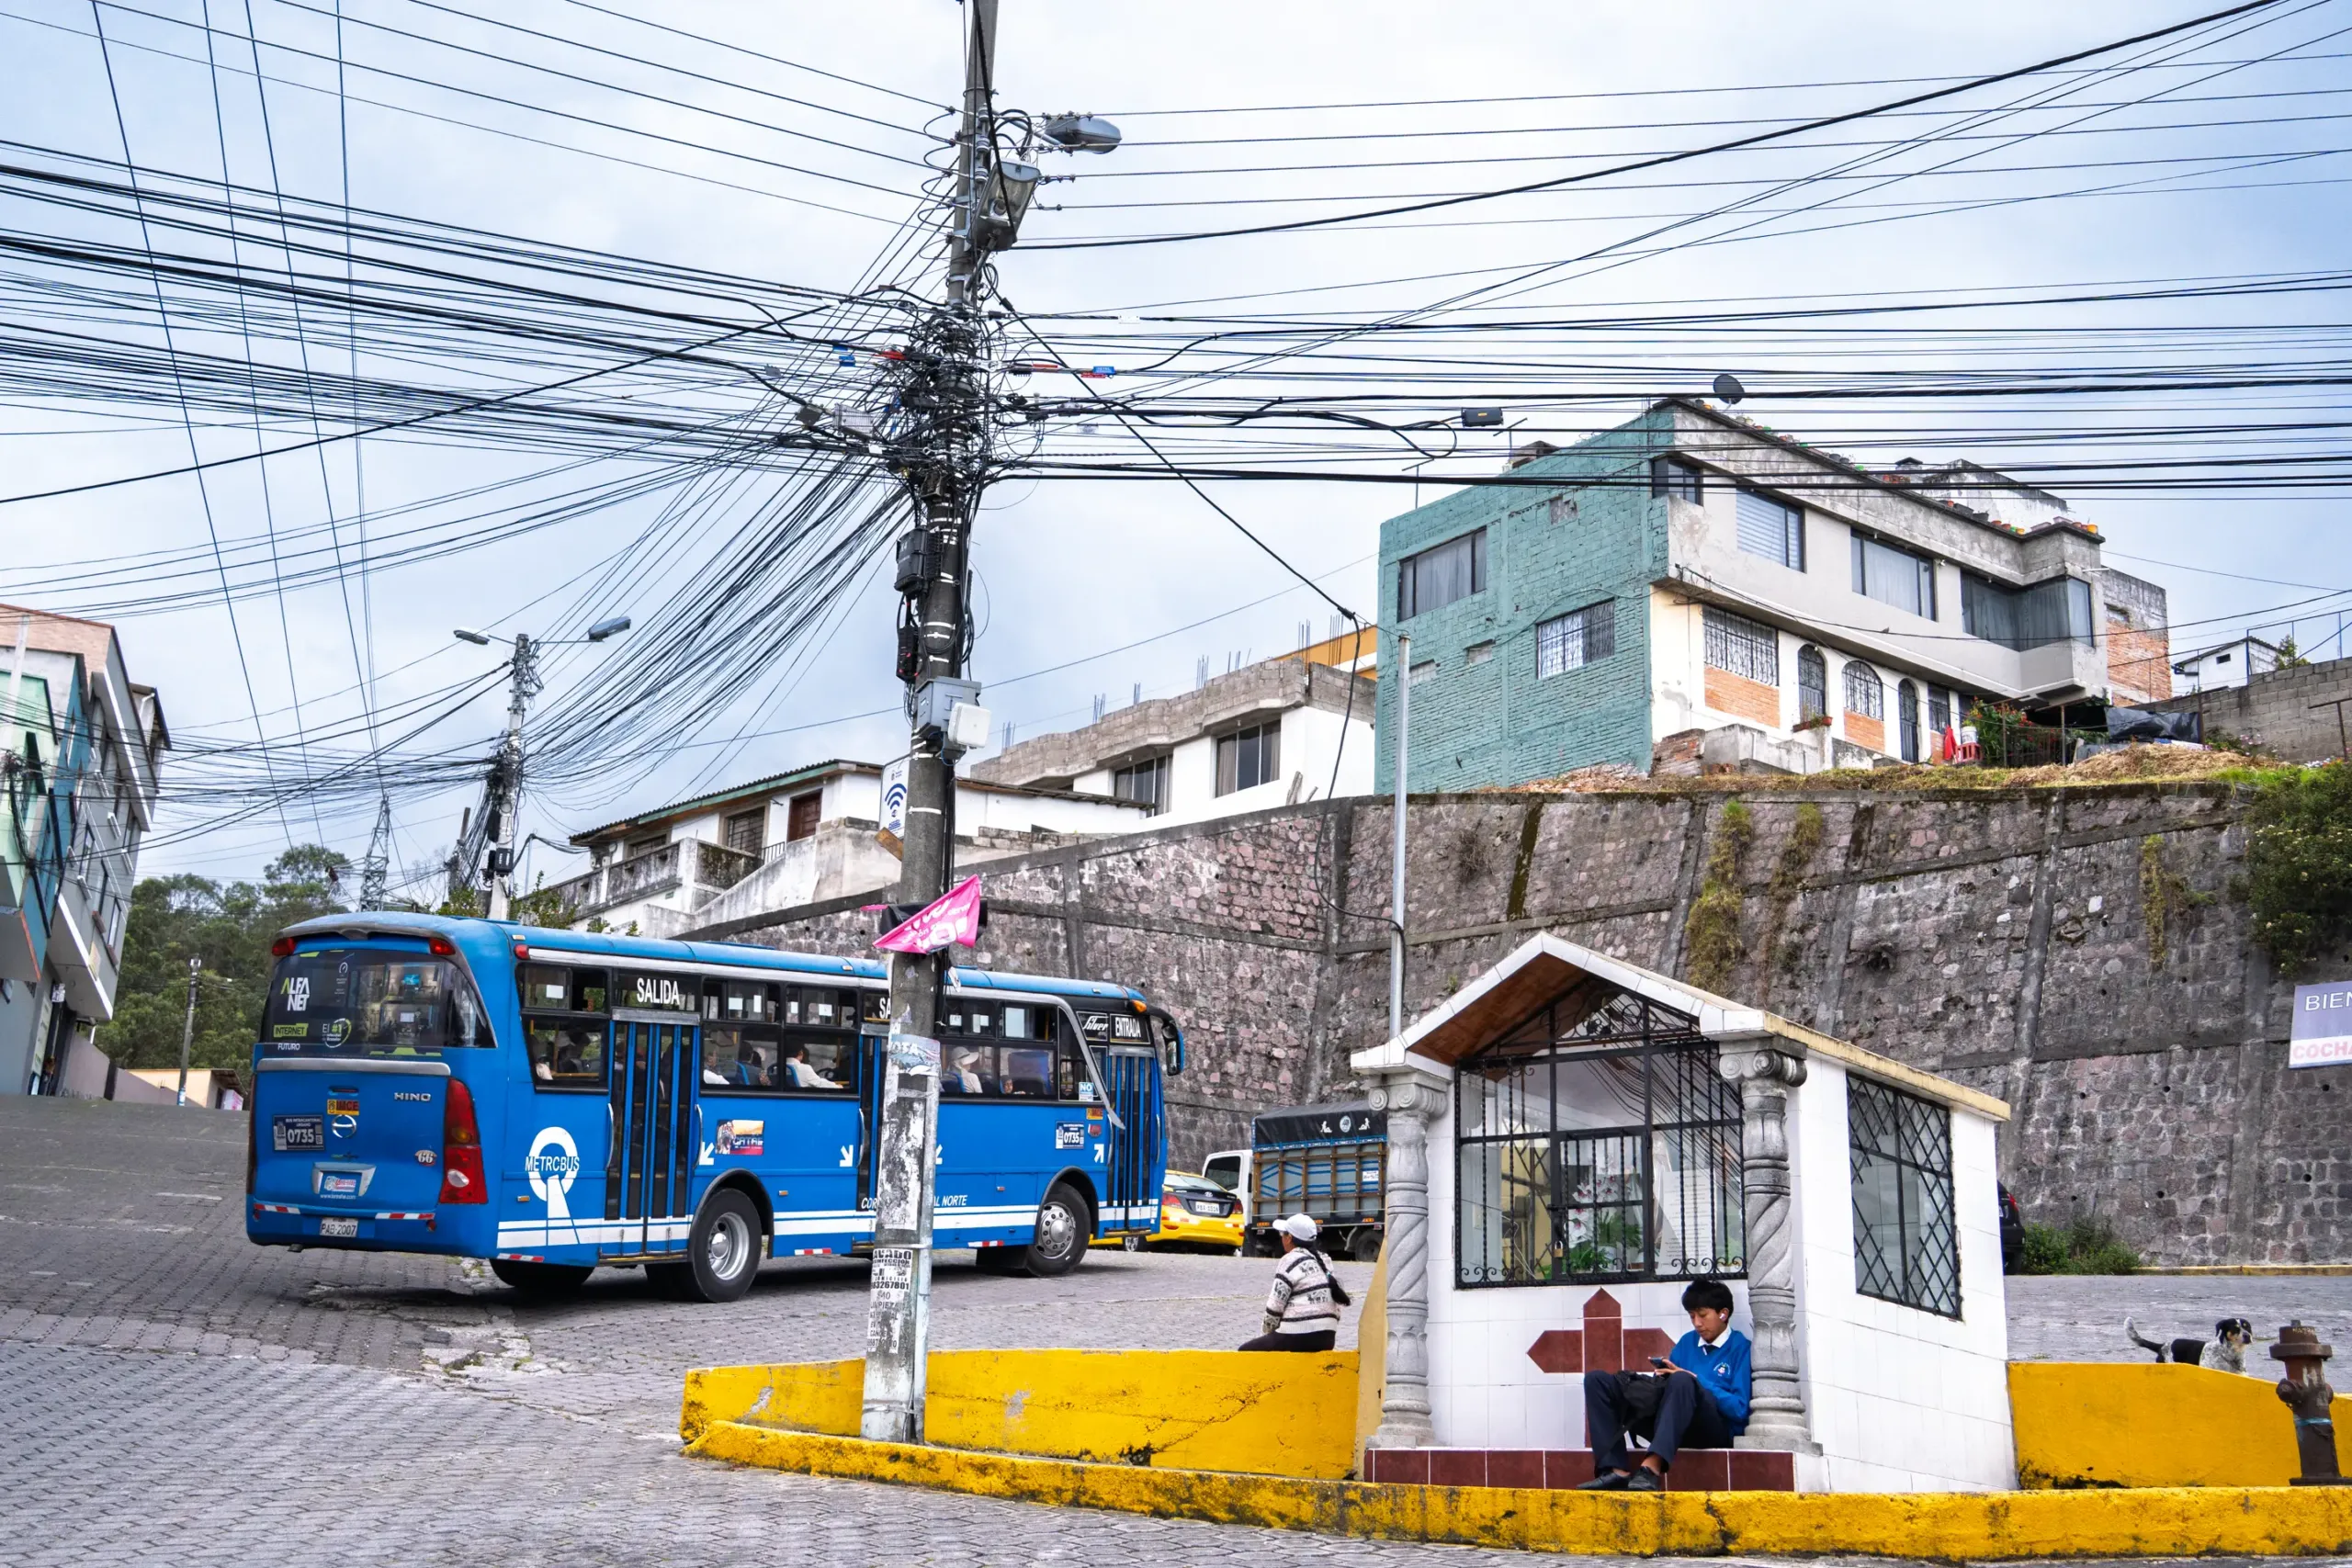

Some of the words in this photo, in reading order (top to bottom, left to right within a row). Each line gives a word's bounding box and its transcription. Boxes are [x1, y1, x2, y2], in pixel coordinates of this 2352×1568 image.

[280, 977, 310, 995] ALFA
[637, 977, 680, 1006] SALIDA
[287, 994, 310, 1011] NET
[275, 1026, 305, 1035] INTERNET
[1114, 1017, 1141, 1038] ENTRADA
[277, 1043, 300, 1051] FUTURO
[2292, 1040, 2352, 1060] COCH
[1080, 1083, 1092, 1092] NO
[394, 1092, 431, 1102] HINO
[288, 1128, 314, 1144] 0735
[1064, 1131, 1080, 1144] 0735
[417, 1155, 434, 1164] 66
[941, 1194, 968, 1207] NORTE
